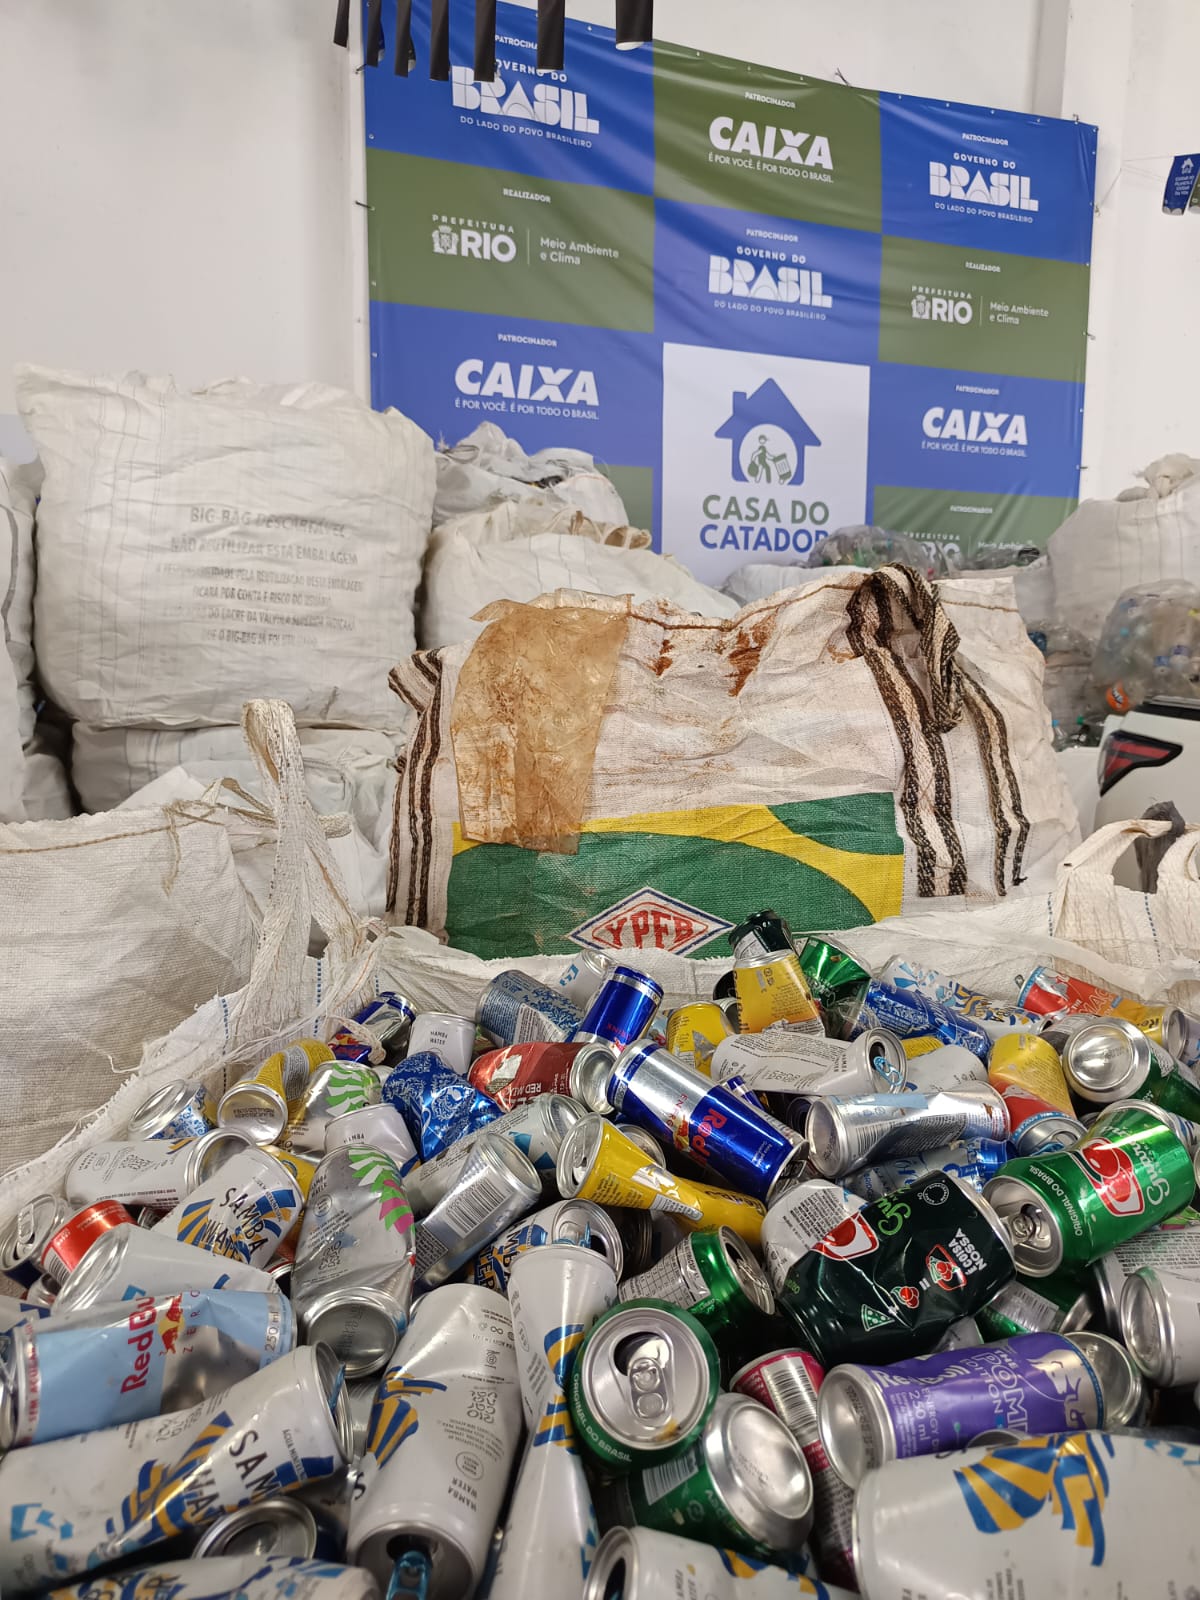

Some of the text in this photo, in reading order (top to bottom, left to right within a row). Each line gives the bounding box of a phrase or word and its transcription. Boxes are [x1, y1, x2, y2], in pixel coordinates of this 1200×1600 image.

[495, 35, 538, 50] PATROCINA
[495, 59, 567, 82] OVERNO DO
[452, 65, 600, 134] BRASIL
[745, 92, 796, 108] PATROCINADOR
[460, 116, 592, 148] DO LADO DO POVO BRASILEIRO
[709, 116, 833, 170] CAIXA
[962, 133, 1008, 146] PATROCINADOR
[715, 156, 730, 164] POR
[762, 164, 778, 173] POR
[780, 166, 800, 176] TODO
[954, 152, 1016, 169] GOVERNO DO
[504, 188, 550, 203] REALIZADOR
[930, 161, 1038, 212] BRASIL
[935, 202, 945, 210] DO
[947, 204, 965, 212] LADO
[978, 209, 996, 218] POVO
[998, 212, 1033, 223] BRASILEIRO
[432, 214, 514, 234] PREFEITURA
[746, 228, 798, 242] PATROCINADOR
[460, 230, 516, 262] RIO
[540, 238, 618, 258] Meio Ambiente
[736, 246, 806, 264] GOVERNO DO
[550, 252, 580, 265] Clima
[966, 261, 1000, 272] REALIZADOR
[708, 254, 832, 308] BRASIL
[912, 286, 972, 299] PREFEITURA
[714, 300, 826, 320] DO LADO DO POVO BRASILEIRO
[932, 297, 972, 324] RIO
[990, 302, 1049, 316] Meio Ambiente
[997, 314, 1019, 324] Clima
[498, 334, 558, 346] PATROCINADOR
[455, 358, 599, 406] CAIXA
[455, 398, 460, 408] É
[462, 400, 480, 409] POR
[510, 402, 515, 412] É
[518, 404, 534, 414] POR
[536, 406, 560, 416] TODO
[563, 409, 570, 418] O
[922, 407, 1028, 446] CAIXA
[967, 445, 980, 453] POR
[981, 446, 998, 454] TODO
[190, 507, 214, 524] BIG
[222, 510, 252, 525] BAG
[702, 494, 829, 525] CASA DO
[267, 544, 293, 560] ESTA
[296, 546, 358, 566] EMBALAGEM
[605, 909, 694, 950] YPFB
[692, 1108, 728, 1155] Red
[1029, 1164, 1083, 1236] ORIGINAL DO BRASIL
[220, 1188, 268, 1254] SAMBA
[948, 1238, 978, 1276] É COISA
[956, 1228, 988, 1270] NOSSA
[120, 1296, 157, 1394] Red Bu
[265, 1326, 280, 1352] 250
[996, 1348, 1018, 1370] THE
[574, 1373, 632, 1462] ORIGINAL DO BRASIL
[910, 1390, 930, 1440] 250 ml
[230, 1430, 281, 1495] SAM
